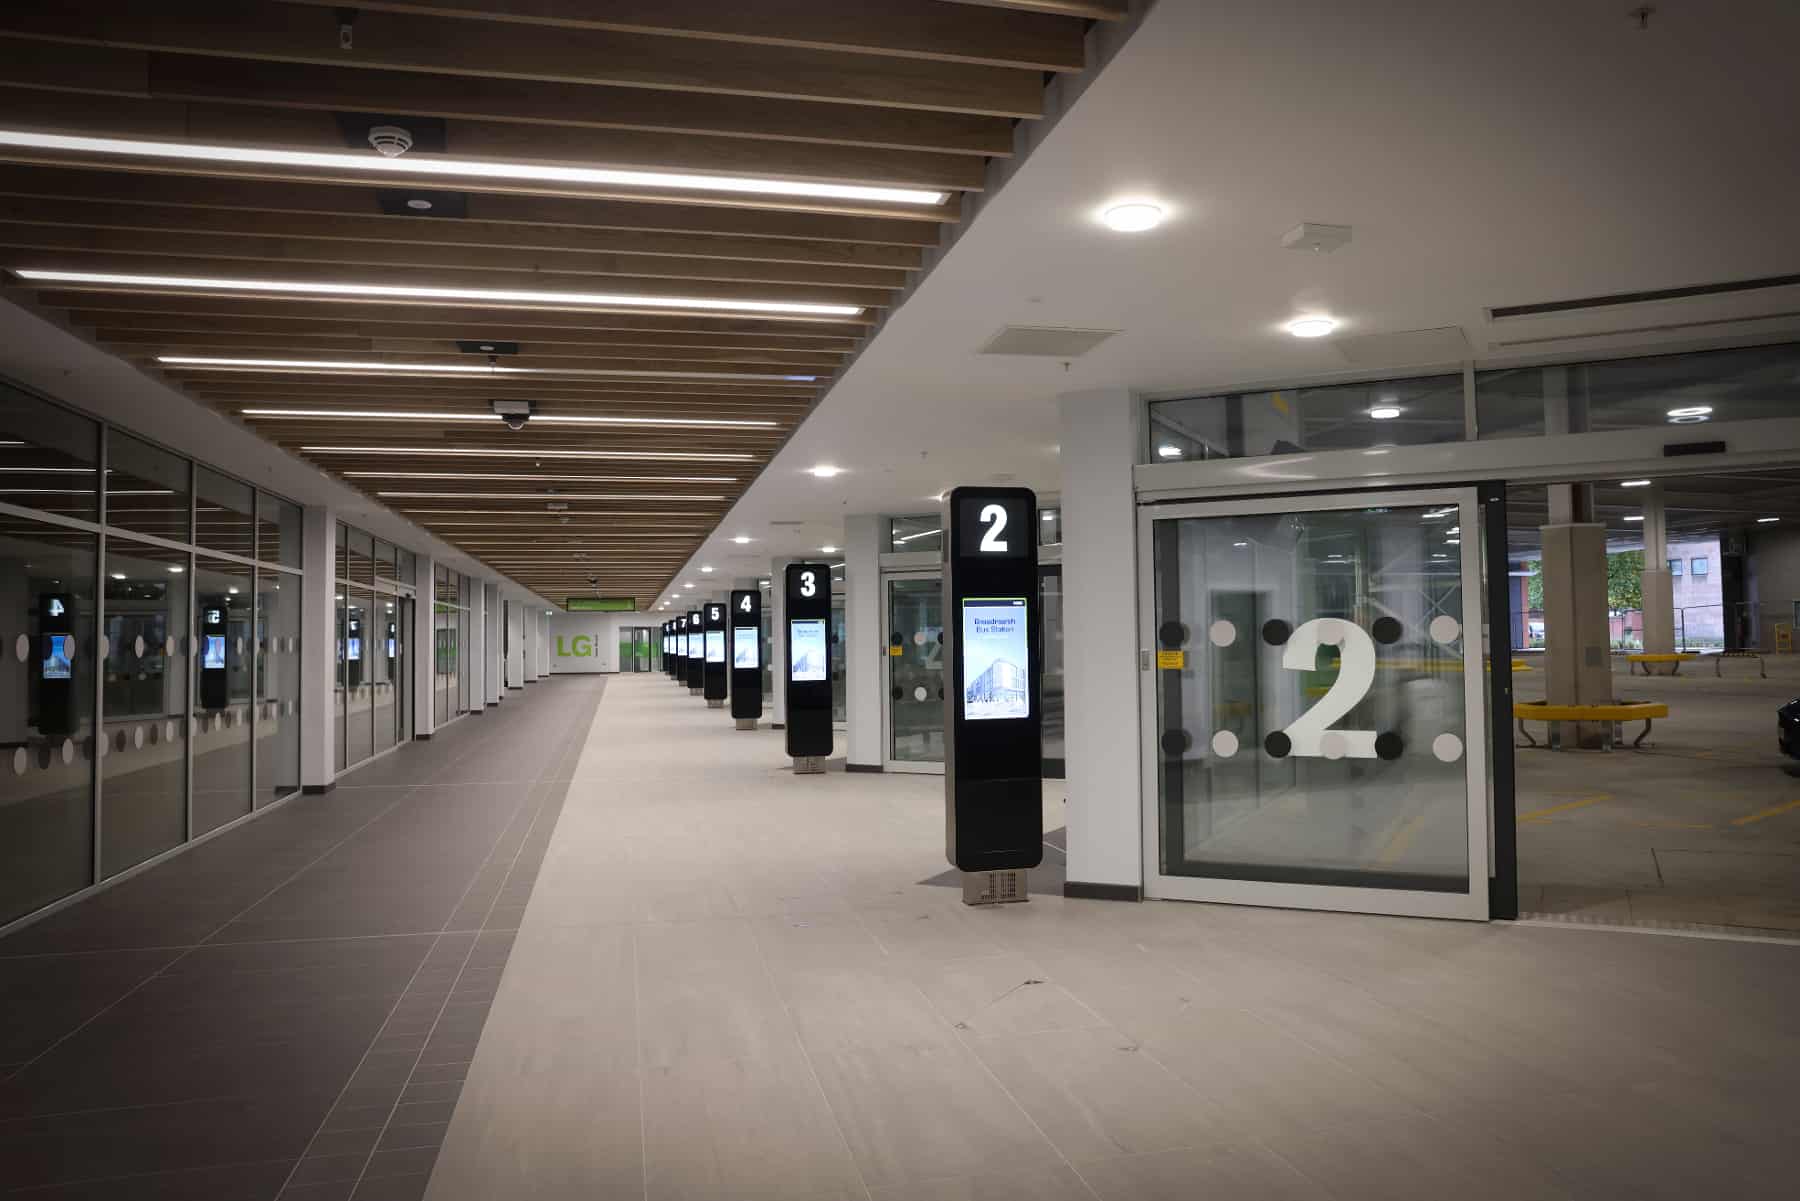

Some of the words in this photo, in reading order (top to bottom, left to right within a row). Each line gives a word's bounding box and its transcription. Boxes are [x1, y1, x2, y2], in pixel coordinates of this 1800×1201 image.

[980, 504, 1008, 551] 2
[800, 571, 816, 597] 3
[711, 607, 719, 620] 5
[740, 595, 752, 612] 4
[680, 618, 687, 628] 7
[693, 613, 700, 625] 6
[556, 634, 592, 657] LG
[1282, 617, 1378, 760] 2
